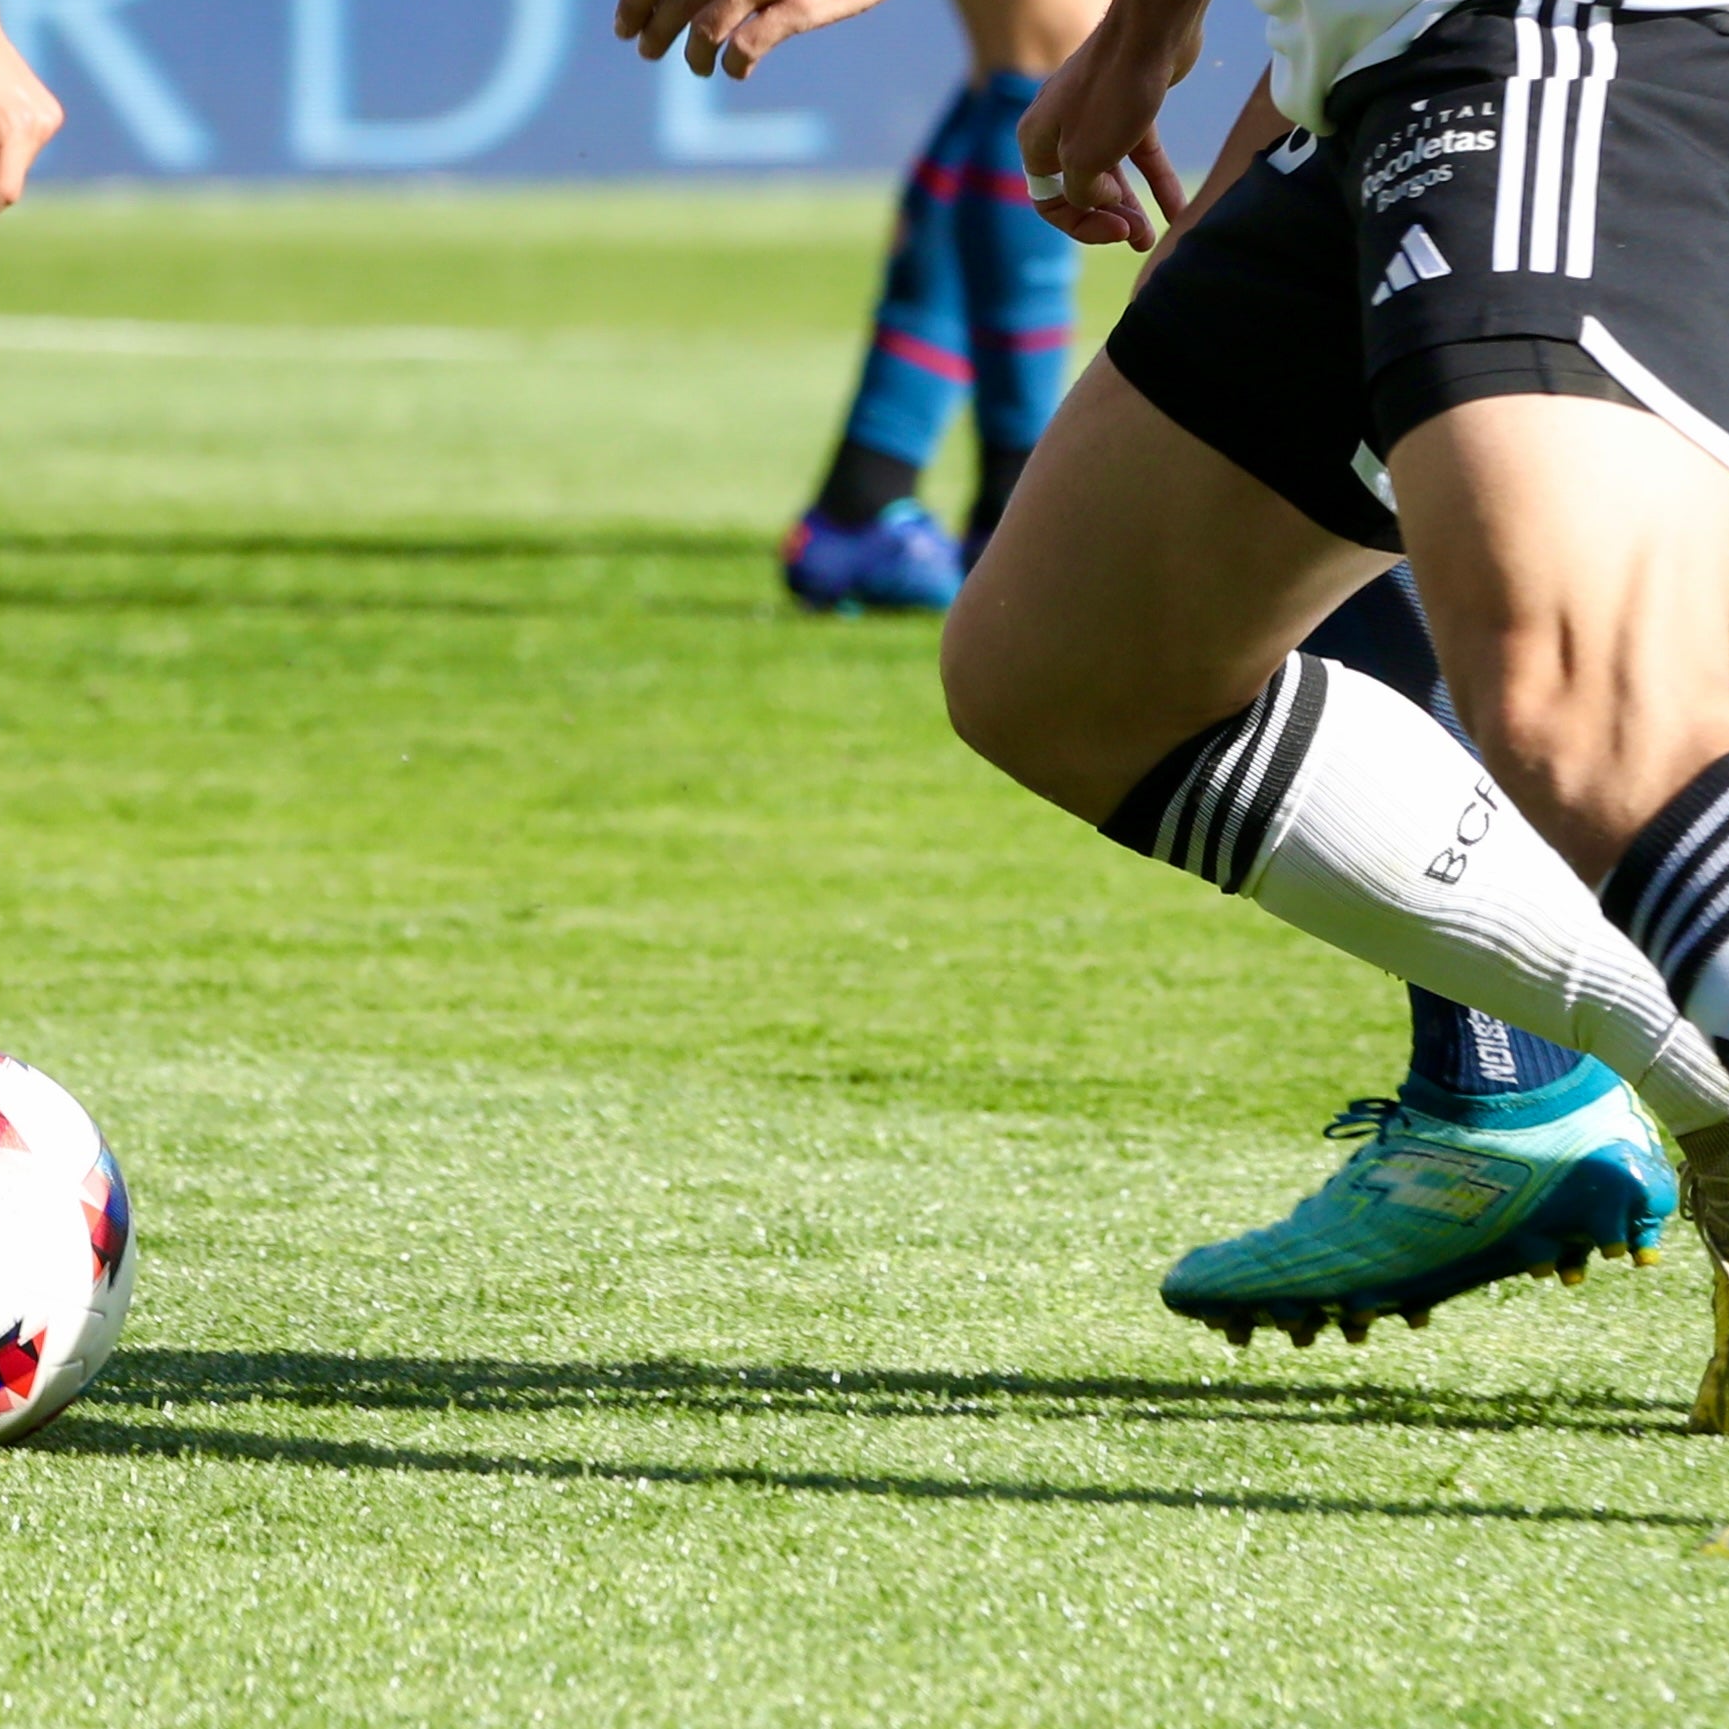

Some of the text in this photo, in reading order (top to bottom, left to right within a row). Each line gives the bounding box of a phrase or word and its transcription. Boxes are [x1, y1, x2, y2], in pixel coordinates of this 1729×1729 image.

[1361, 129, 1497, 207] Recoletas
[1376, 163, 1454, 213] Burgos
[1423, 775, 1498, 885] BCF
